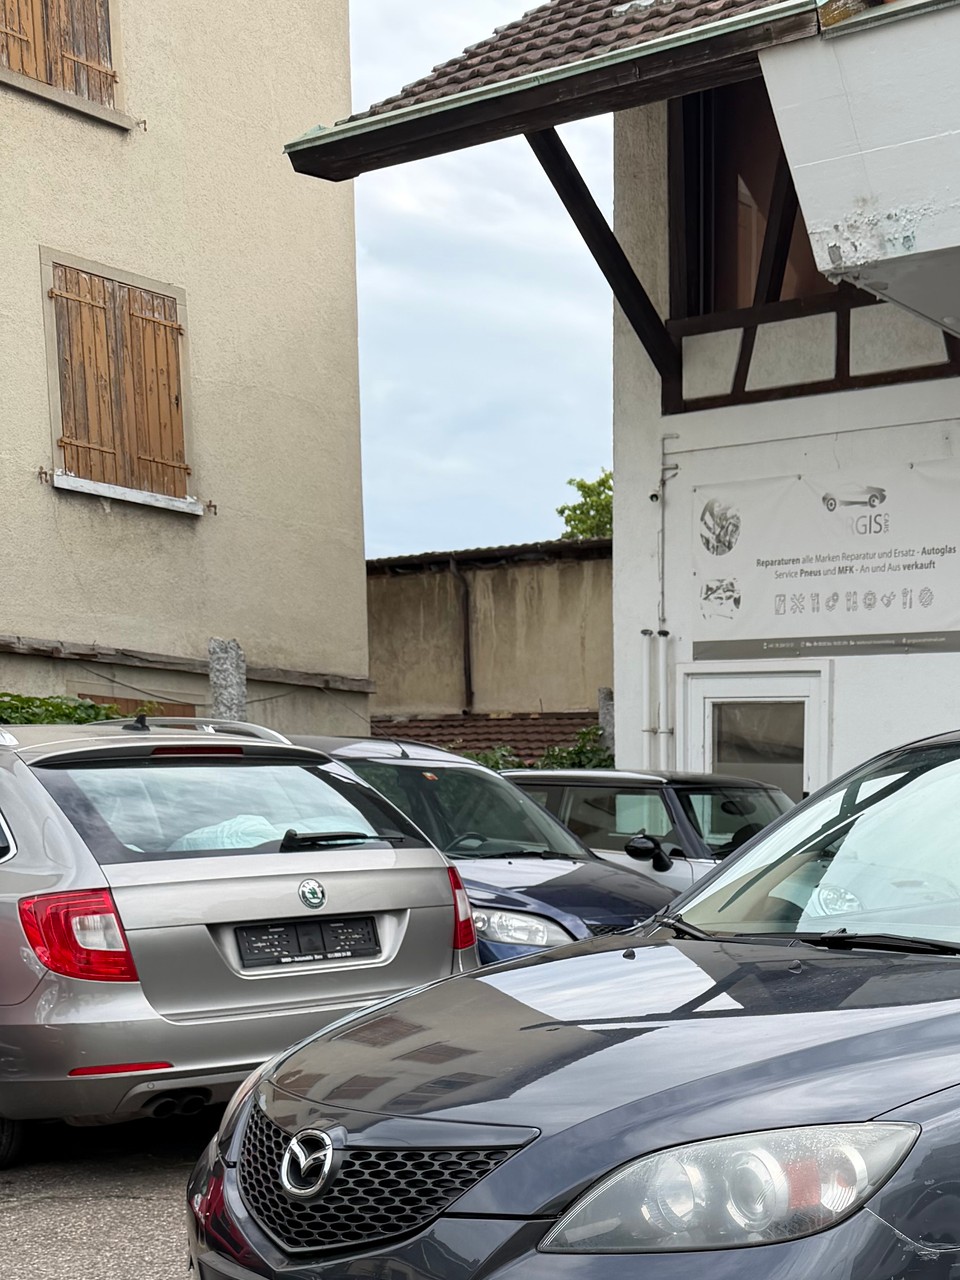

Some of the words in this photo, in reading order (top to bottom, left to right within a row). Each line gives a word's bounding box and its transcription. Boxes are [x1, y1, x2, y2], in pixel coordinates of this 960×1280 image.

[756, 557, 801, 568] Reparaturen
[802, 554, 813, 564] alle
[815, 553, 840, 564] Marken
[841, 551, 876, 563] Reparatur
[878, 549, 892, 559] und
[893, 548, 915, 558] Ersatz
[921, 545, 957, 557] Autoglas
[774, 570, 798, 580] Service
[799, 568, 821, 578] Pneus
[822, 566, 837, 576] und
[837, 565, 854, 575] MFK
[860, 565, 870, 574] An
[871, 563, 886, 573] und
[887, 562, 901, 572] Aus
[902, 559, 936, 571] verkauft
